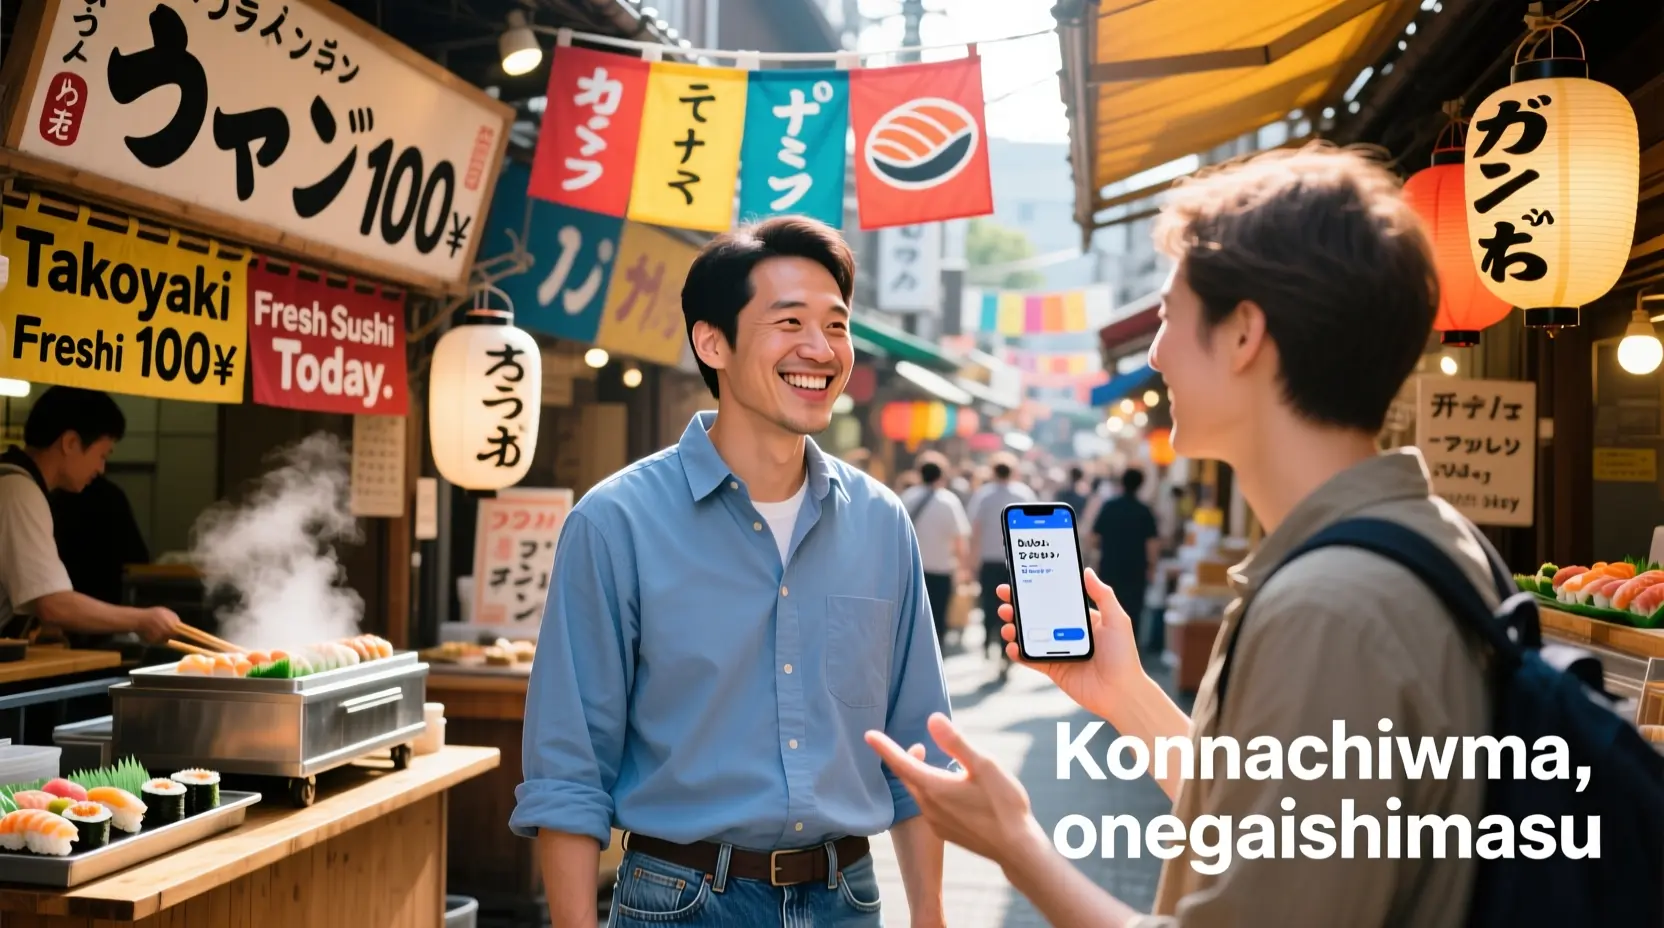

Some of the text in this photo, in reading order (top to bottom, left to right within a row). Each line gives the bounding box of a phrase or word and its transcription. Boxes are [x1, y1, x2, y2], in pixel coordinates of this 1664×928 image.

[15, 225, 231, 322] Takoyaki
[13, 314, 237, 386] Freshi 100¥
[254, 289, 395, 348] Fresh Sushi
[271, 337, 393, 409] Today.
